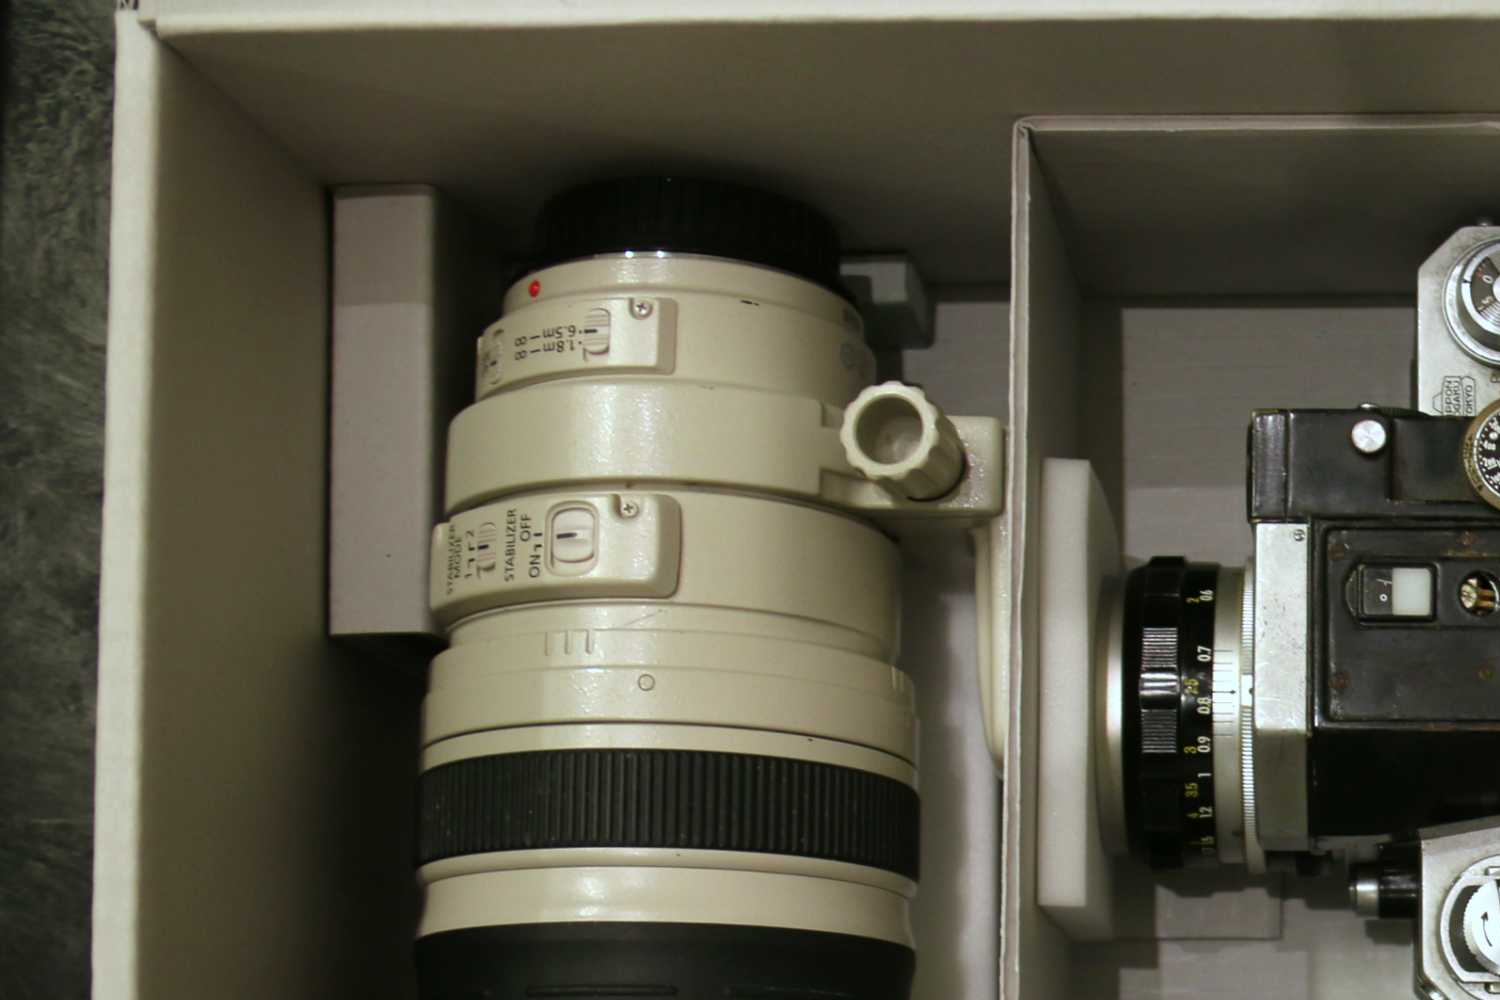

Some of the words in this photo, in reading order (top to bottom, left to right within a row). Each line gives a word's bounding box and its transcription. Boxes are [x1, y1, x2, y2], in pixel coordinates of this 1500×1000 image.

[1464, 384, 1473, 414] OKYO
[520, 514, 531, 542] OFF
[504, 508, 517, 582] STABILIZER
[529, 555, 541, 578] ON
